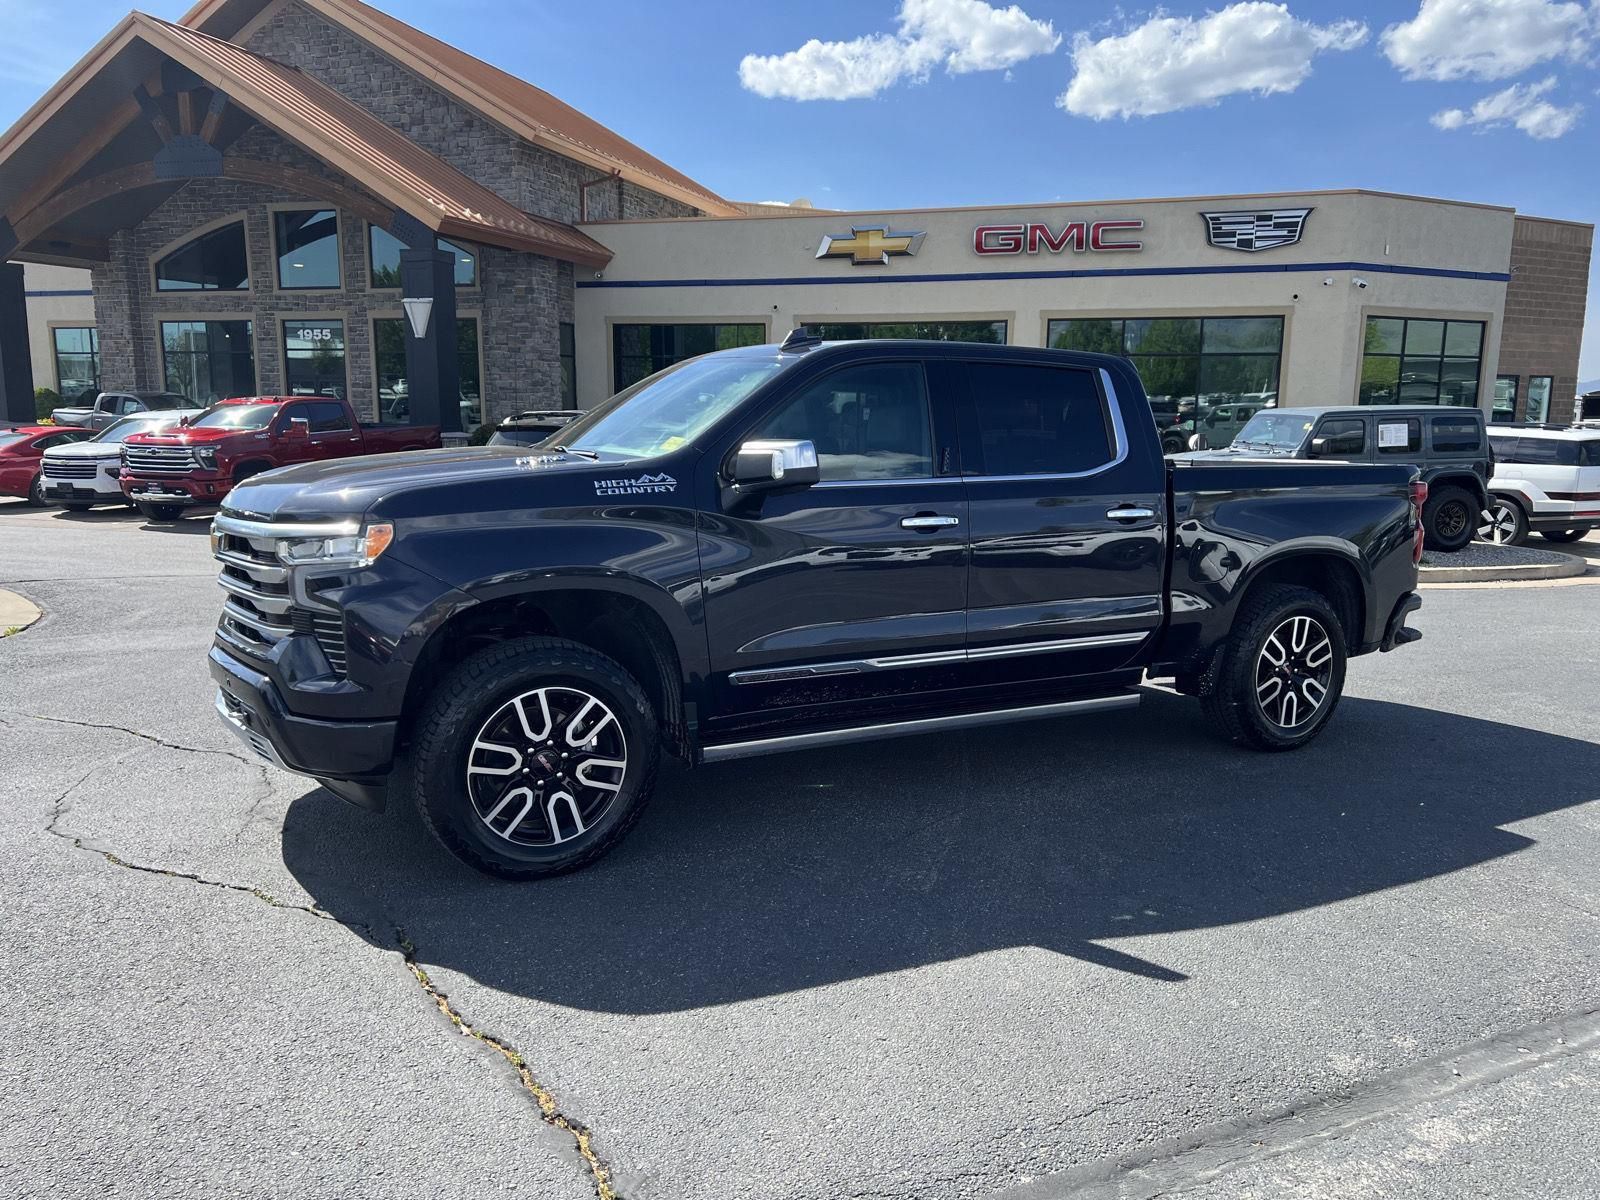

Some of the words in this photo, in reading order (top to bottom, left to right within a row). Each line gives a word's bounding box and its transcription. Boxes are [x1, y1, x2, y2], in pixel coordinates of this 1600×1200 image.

[973, 220, 1144, 256] GMC
[297, 329, 332, 340] 1955
[594, 478, 637, 488] HIGH
[596, 485, 677, 496] COUNTRY
